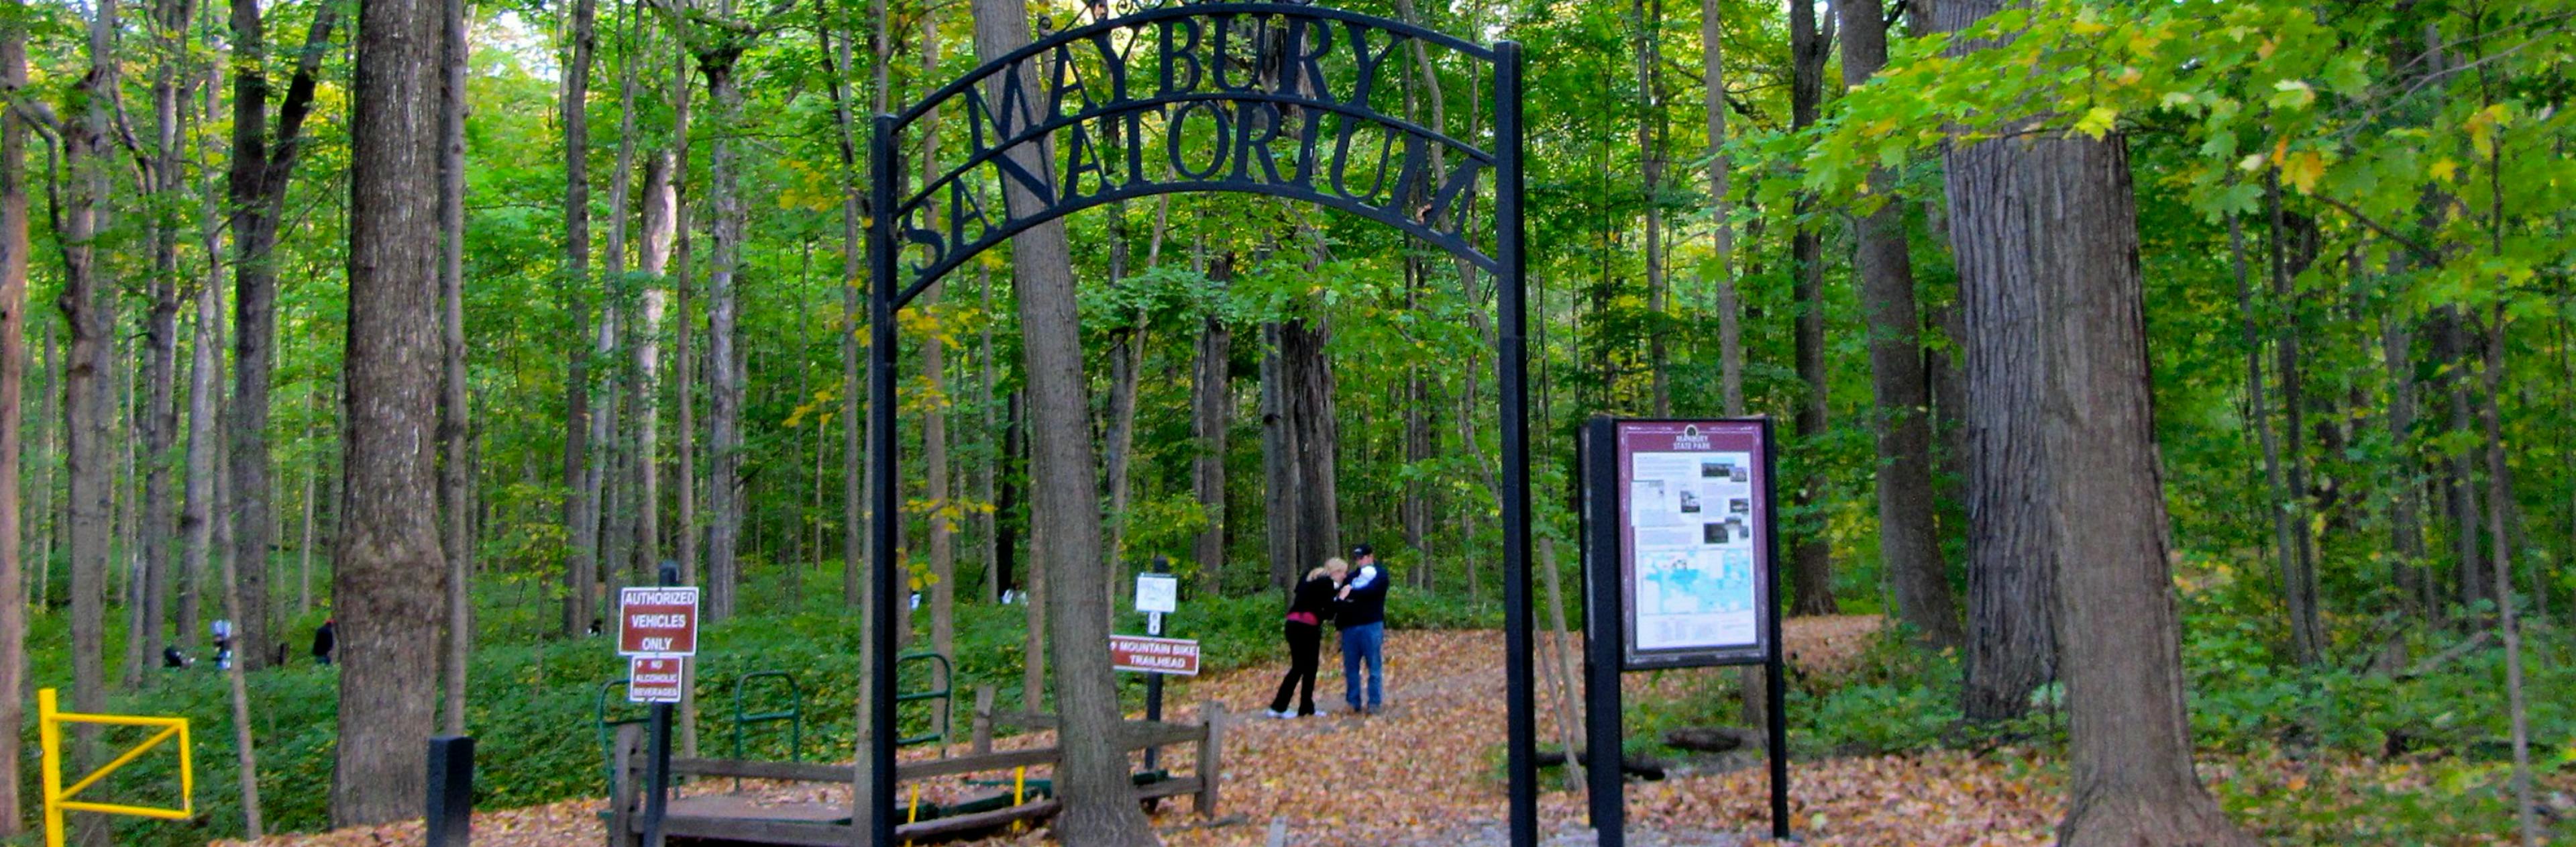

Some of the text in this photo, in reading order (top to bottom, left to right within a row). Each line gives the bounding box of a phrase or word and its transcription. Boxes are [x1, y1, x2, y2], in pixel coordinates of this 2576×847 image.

[964, 12, 1409, 161] MAYBURY
[901, 98, 1492, 276] SANATORIUM
[625, 592, 696, 605] AUTHORIZED
[632, 614, 686, 628] VEHICLES
[642, 638, 673, 650] ONLY
[1119, 640, 1196, 656] MOUNTAIN BIKE
[651, 660, 663, 669] NO
[1130, 654, 1185, 668] TRAILHEAD
[635, 673, 678, 683] ALCOHOLIC
[633, 687, 678, 697] BEVERAGES
